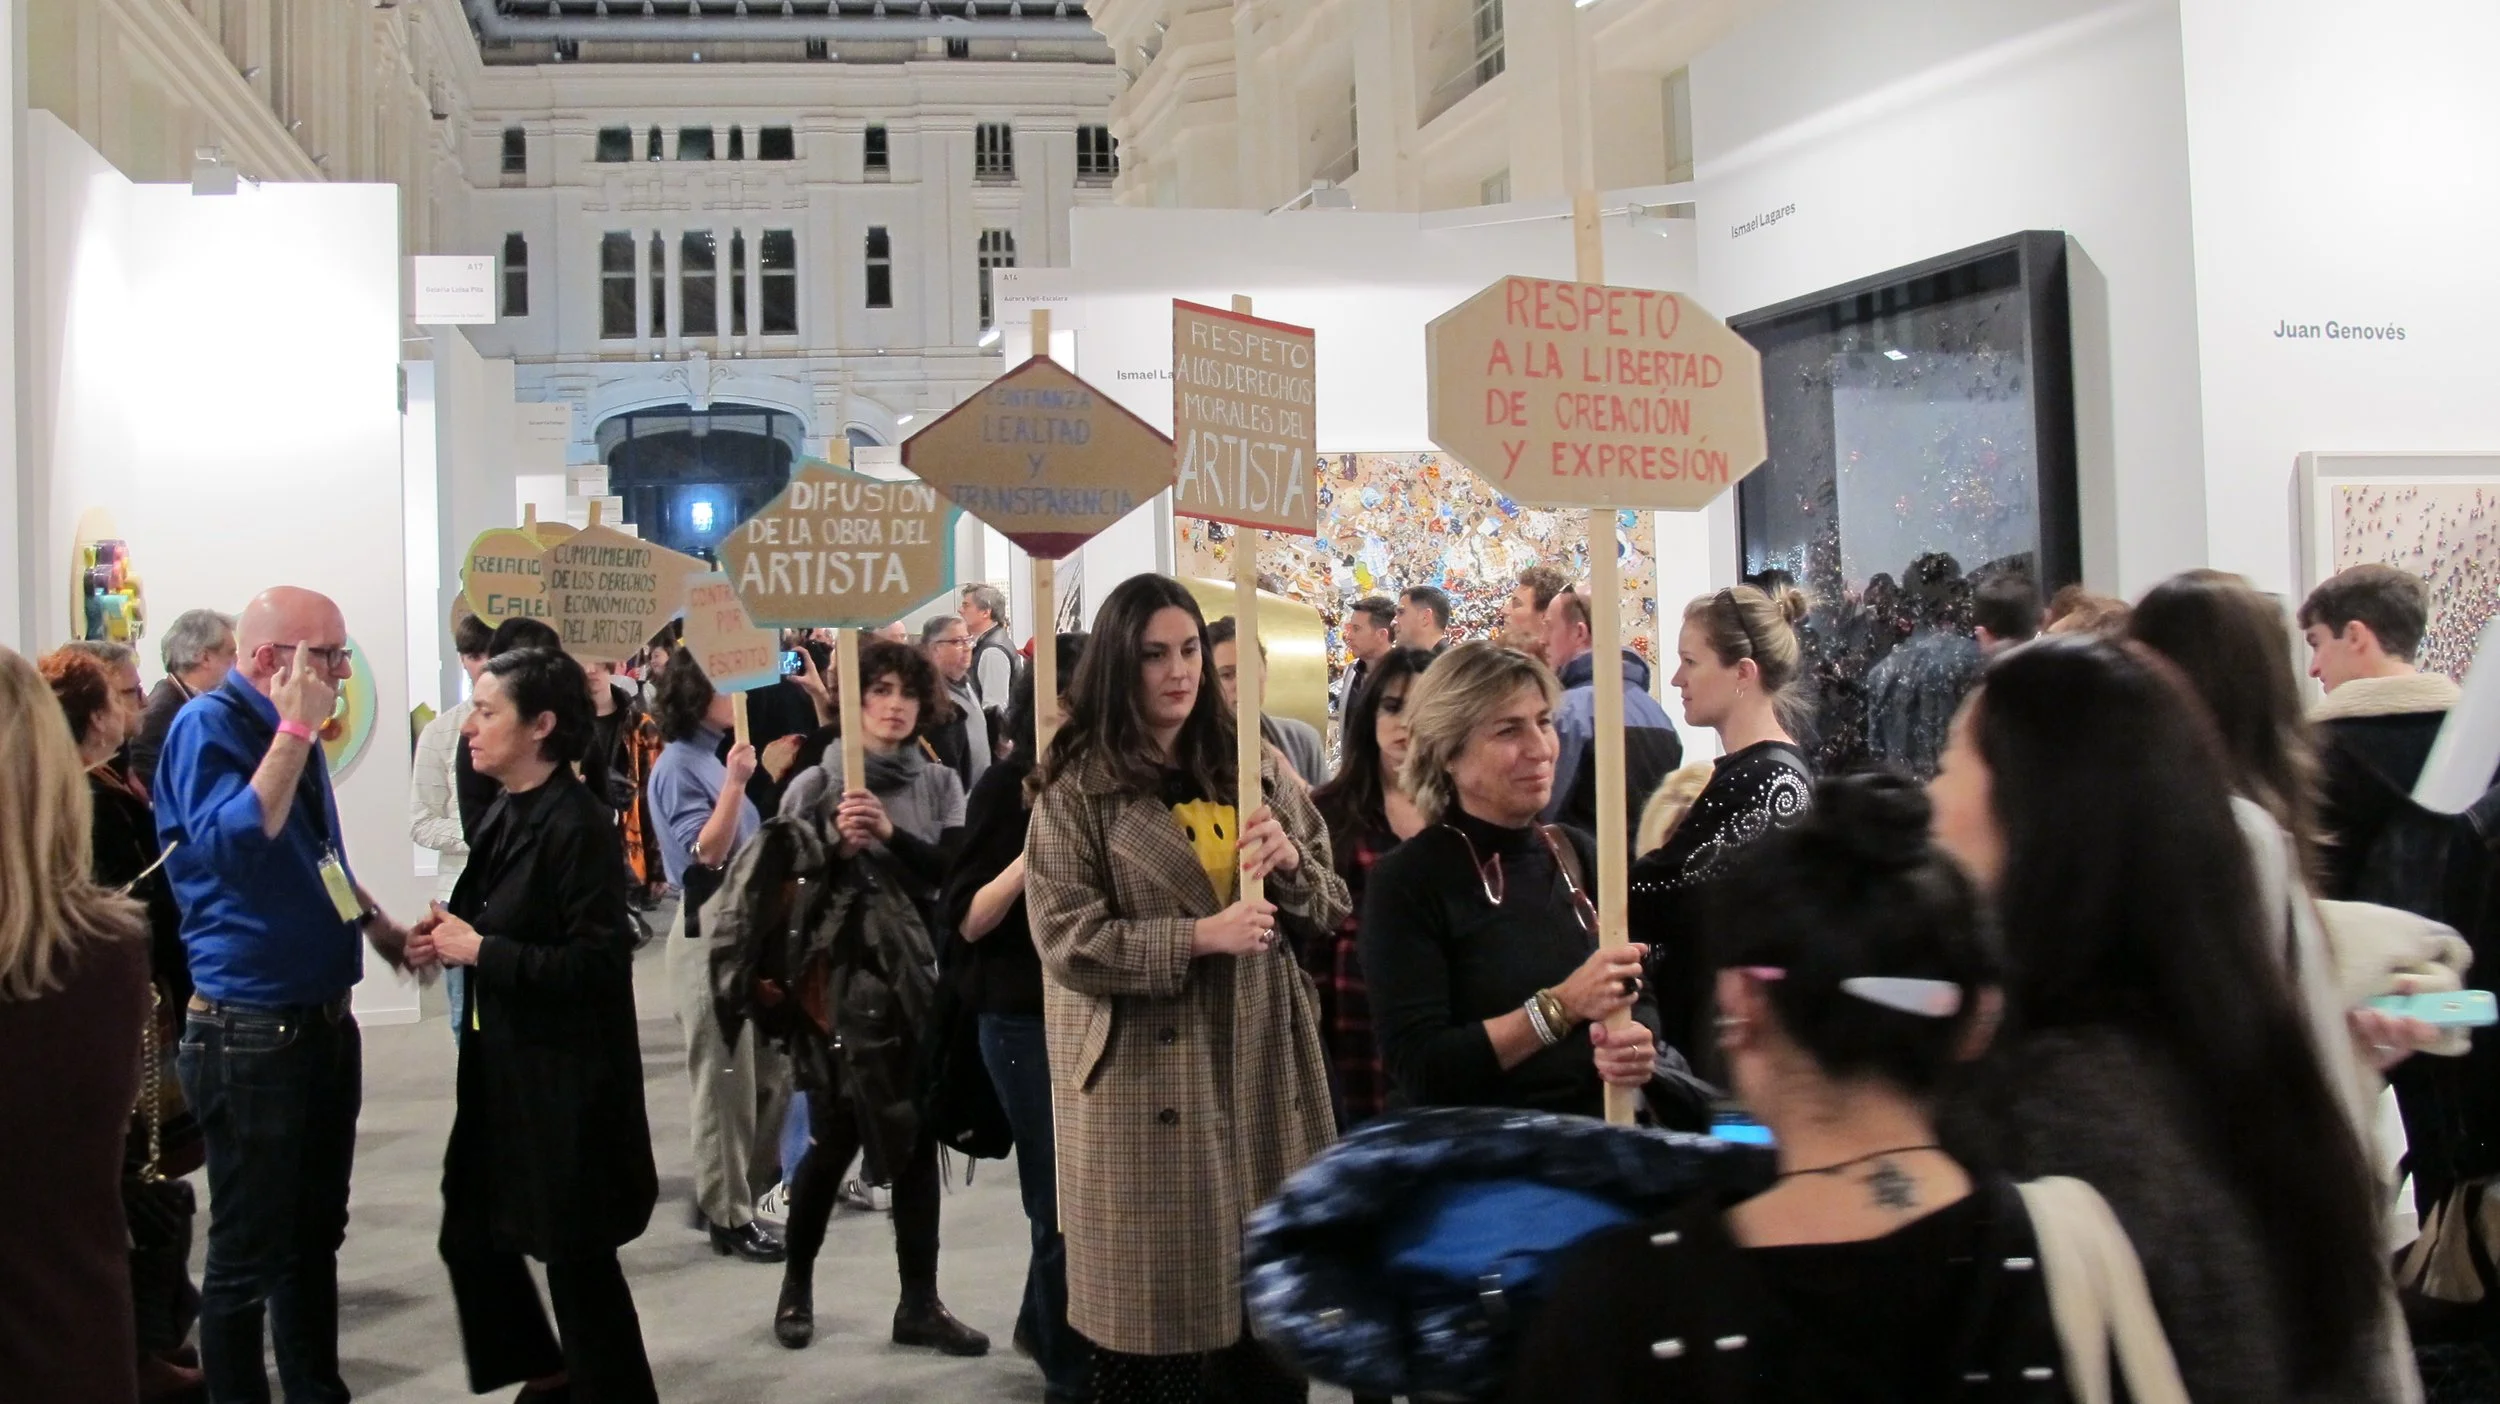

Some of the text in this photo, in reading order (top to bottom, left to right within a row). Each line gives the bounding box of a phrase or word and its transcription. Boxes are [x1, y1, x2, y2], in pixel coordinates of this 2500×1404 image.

[1731, 203, 1796, 239] Ismael Lagares
[1506, 279, 1680, 339] RESPETO
[1192, 321, 1309, 368] RESPETO
[2273, 320, 2406, 340] Juan Genovés
[1117, 369, 1157, 380] Ismael
[1176, 354, 1313, 405] A LOS DERECHOS
[1487, 338, 1723, 388] A LA LIBERTAD
[1185, 392, 1307, 440] MORALES DEL
[1486, 388, 1691, 435] DE CREACIÓN
[983, 415, 1091, 446] LEALTAD
[1175, 428, 1308, 520] ARTISTA
[1502, 435, 1729, 484] Y EXPRESIÓN
[953, 485, 1133, 514] TRANSPARENCIA
[748, 518, 931, 546] DE LA OBRA DEL
[555, 544, 652, 568] CUMPLIMIENTO
[739, 551, 909, 595] ARTISTA
[552, 569, 571, 589] DE
[573, 570, 594, 590] LOS
[599, 572, 656, 592] DERECHOS
[564, 593, 656, 615] ECONÓMICOS
[563, 619, 643, 644] DEL ARTISTA
